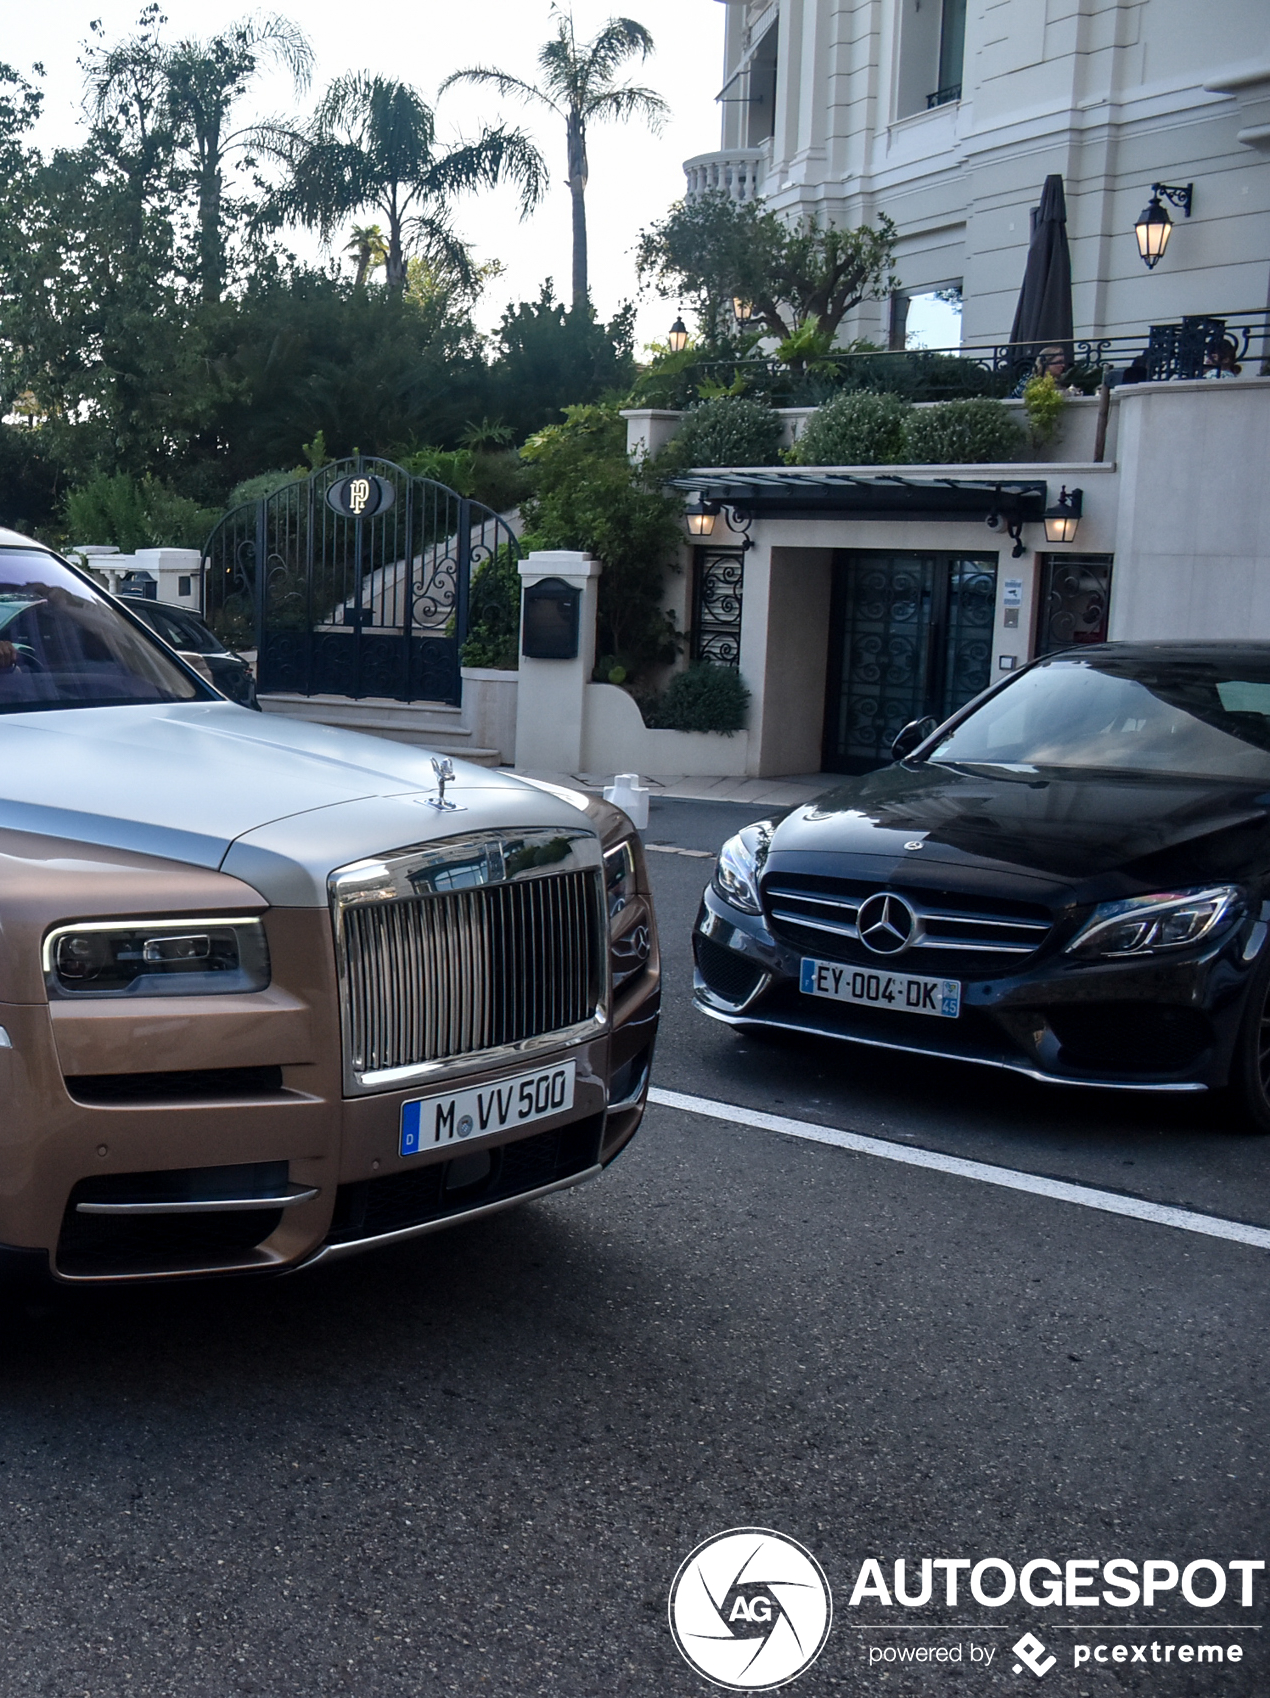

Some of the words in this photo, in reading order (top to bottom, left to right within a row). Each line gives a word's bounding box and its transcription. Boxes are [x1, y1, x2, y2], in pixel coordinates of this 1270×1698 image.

[817, 966, 938, 1010] EY-004-DK
[942, 1000, 958, 1014] 45
[435, 1100, 456, 1142] M
[406, 1134, 414, 1146] D
